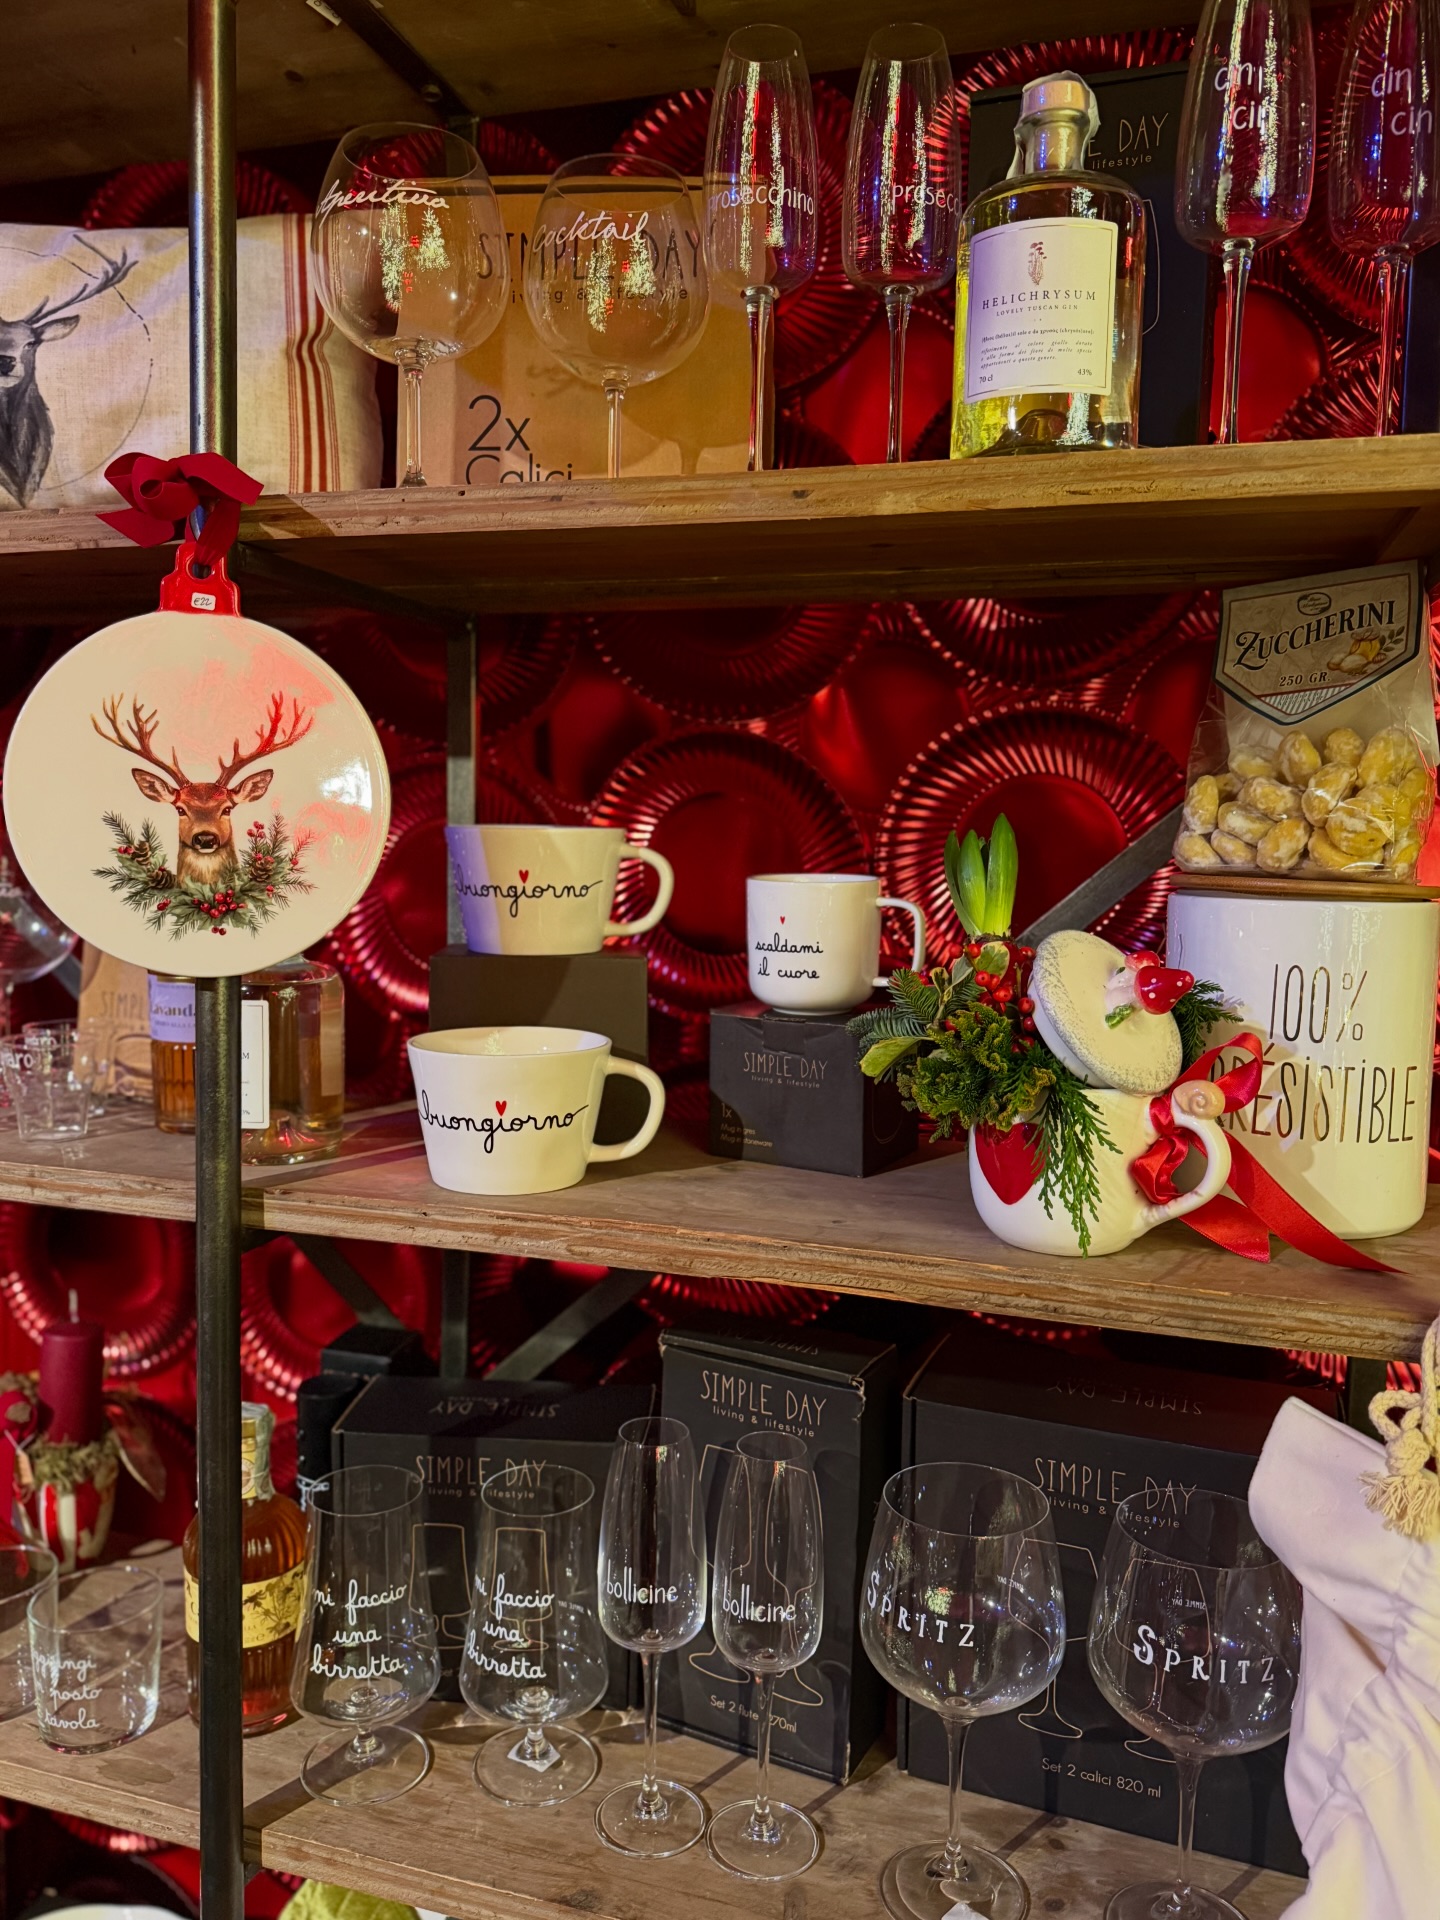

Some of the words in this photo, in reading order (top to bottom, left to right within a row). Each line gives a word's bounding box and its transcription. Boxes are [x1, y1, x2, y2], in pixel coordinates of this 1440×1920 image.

[1232, 100, 1274, 130] cin
[1391, 106, 1433, 135] cin
[1119, 112, 1169, 152] DAY
[1092, 154, 1152, 170] lifestyle
[982, 289, 1096, 310] HELICHRYSUM
[996, 307, 1024, 317] LOVELY
[1027, 304, 1059, 312] TUSCAN
[1077, 368, 1092, 376] 43%
[468, 394, 531, 451] 2x
[193, 596, 212, 606] €22
[1232, 600, 1396, 671] ZUCCHERINI
[1278, 674, 1303, 687] 250
[1309, 671, 1331, 684] GR.
[455, 864, 603, 918] buongiorno
[755, 932, 824, 954] scaldami
[757, 956, 770, 977] il
[777, 967, 821, 979] cuore
[153, 1003, 196, 1017] avand
[1269, 963, 1368, 1043] 100%
[743, 1051, 792, 1077] SIMPLE
[800, 1057, 828, 1080] DAY
[751, 1075, 773, 1084] living
[787, 1079, 820, 1088] lifestyle
[418, 1089, 589, 1154] buongiorno
[700, 1370, 773, 1415] SIMPLE
[786, 1390, 827, 1426] DAY
[713, 1405, 745, 1422] living
[751, 1415, 758, 1424] &
[764, 1418, 815, 1438] lifestyle
[413, 1455, 493, 1486] SIMPLE
[505, 1458, 547, 1487] DAY
[1031, 1457, 1126, 1504] SIMPLE
[1145, 1476, 1197, 1515] DAY
[428, 1487, 463, 1497] living
[485, 1489, 535, 1499] lifestyle
[1049, 1497, 1089, 1514] living
[1098, 1506, 1106, 1515] &
[606, 1558, 679, 1604] bollicine
[345, 1579, 407, 1626] faccio
[493, 1573, 555, 1620] faccio
[722, 1575, 797, 1623] bollicine
[867, 1570, 975, 1647] SPRITZ
[332, 1629, 382, 1643] una
[482, 1621, 524, 1642] una
[310, 1643, 405, 1679] birretta
[468, 1629, 547, 1678] birretta
[1133, 1624, 1274, 1684] SPRITZ
[50, 1685, 103, 1711] posto
[710, 1694, 726, 1710] Set
[729, 1702, 736, 1713] 2
[739, 1704, 759, 1721] flute
[44, 1707, 100, 1729] tavola
[1042, 1757, 1062, 1773] Set
[1067, 1763, 1076, 1777] 2
[1080, 1770, 1112, 1786] calici
[1116, 1776, 1144, 1793] 820
[1147, 1785, 1161, 1798] ml
